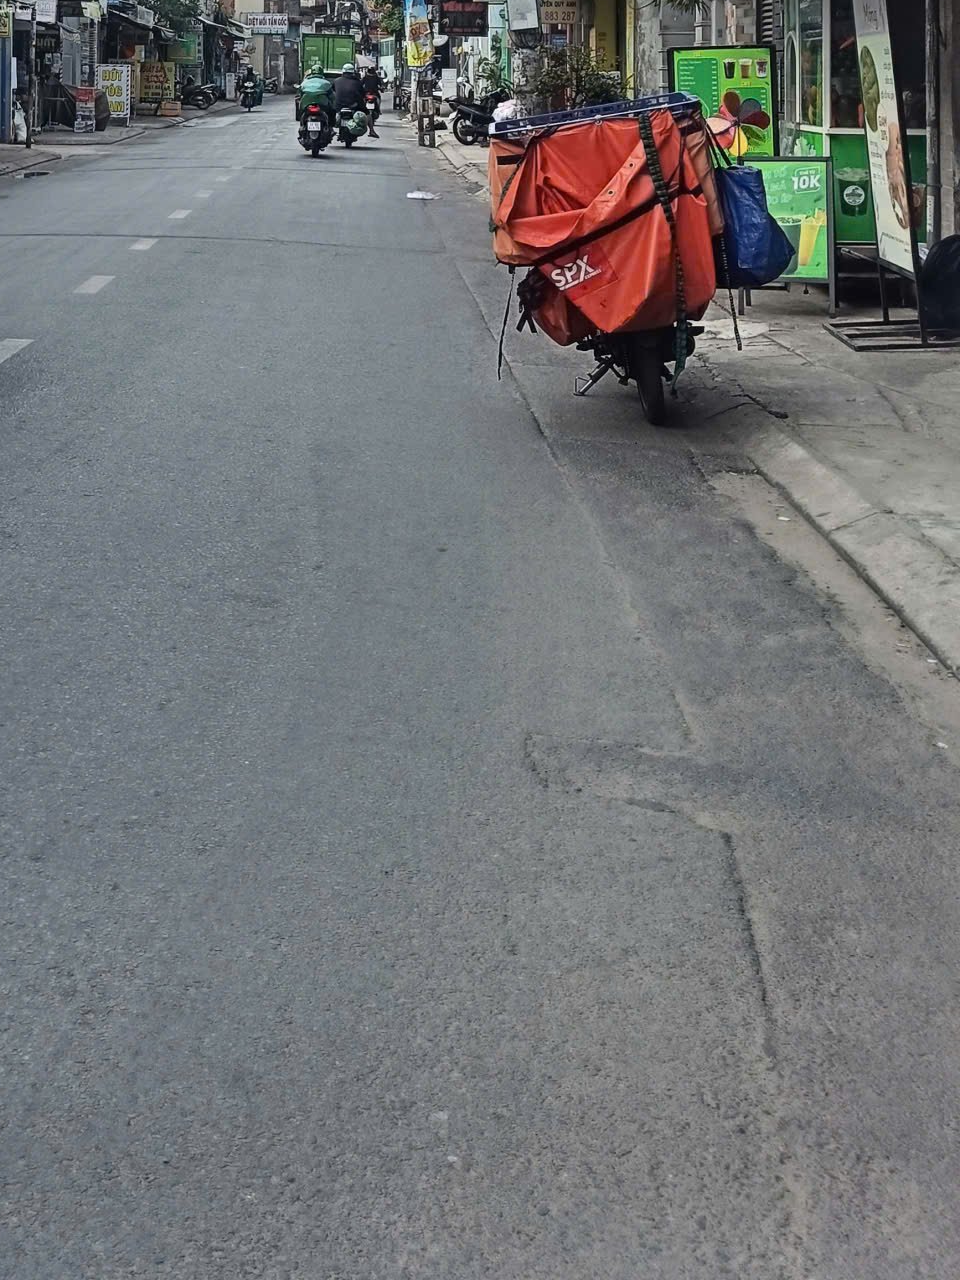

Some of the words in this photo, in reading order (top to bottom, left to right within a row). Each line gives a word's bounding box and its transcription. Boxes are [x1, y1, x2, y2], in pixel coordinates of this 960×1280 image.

[562, 11, 576, 21] 287
[791, 175, 821, 190] 10K
[551, 254, 595, 288] SPX
